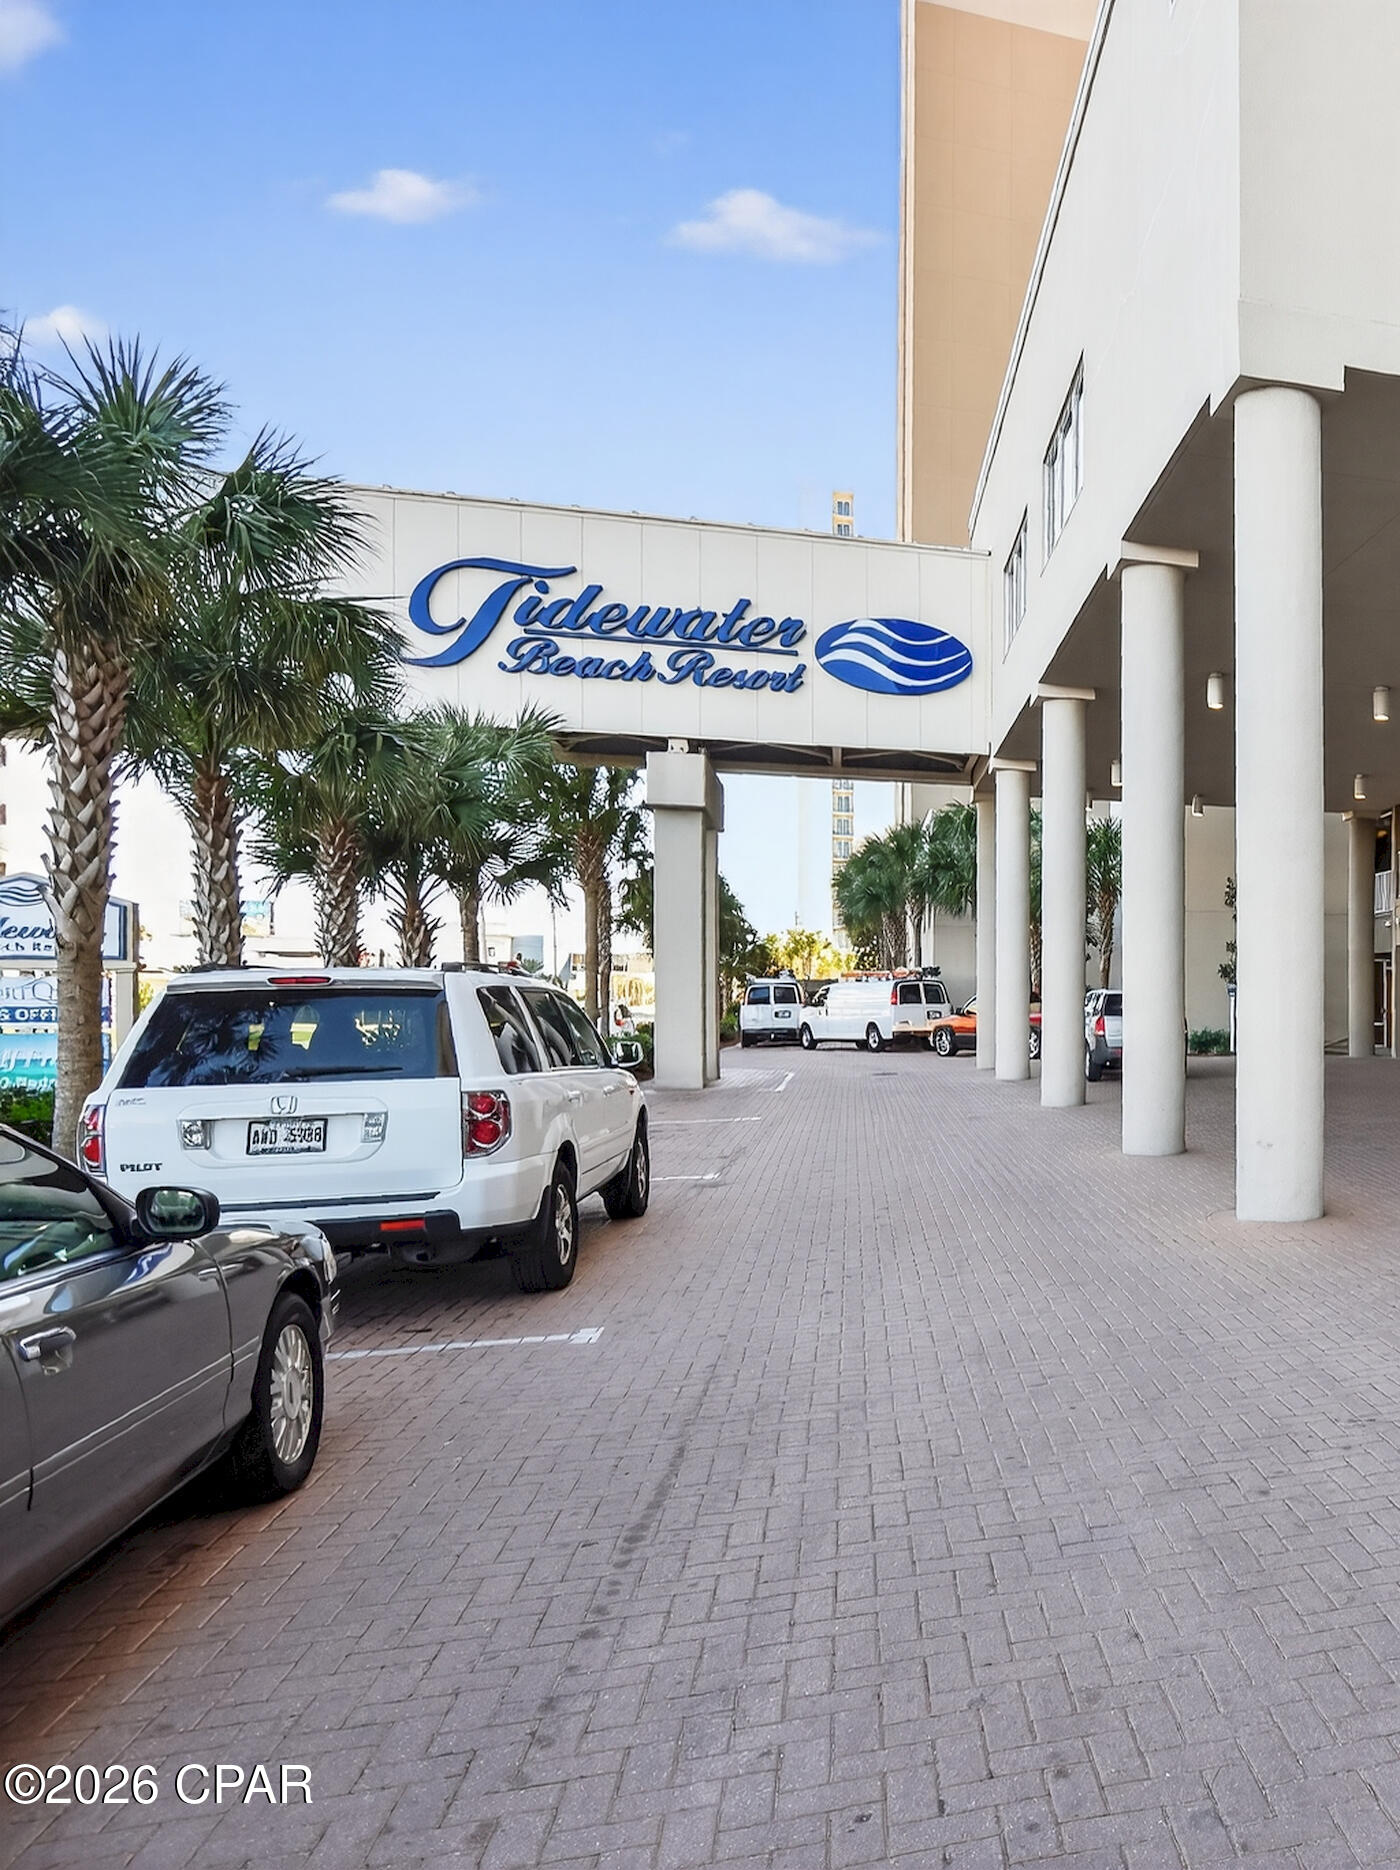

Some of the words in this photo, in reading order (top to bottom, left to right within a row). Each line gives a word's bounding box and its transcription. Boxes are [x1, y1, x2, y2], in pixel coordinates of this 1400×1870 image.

[402, 557, 807, 667] Tidewater
[498, 637, 657, 683] Beach
[657, 650, 807, 694] Resort
[15, 1008, 57, 1021] OFFI
[119, 1162, 163, 1173] PILOT
